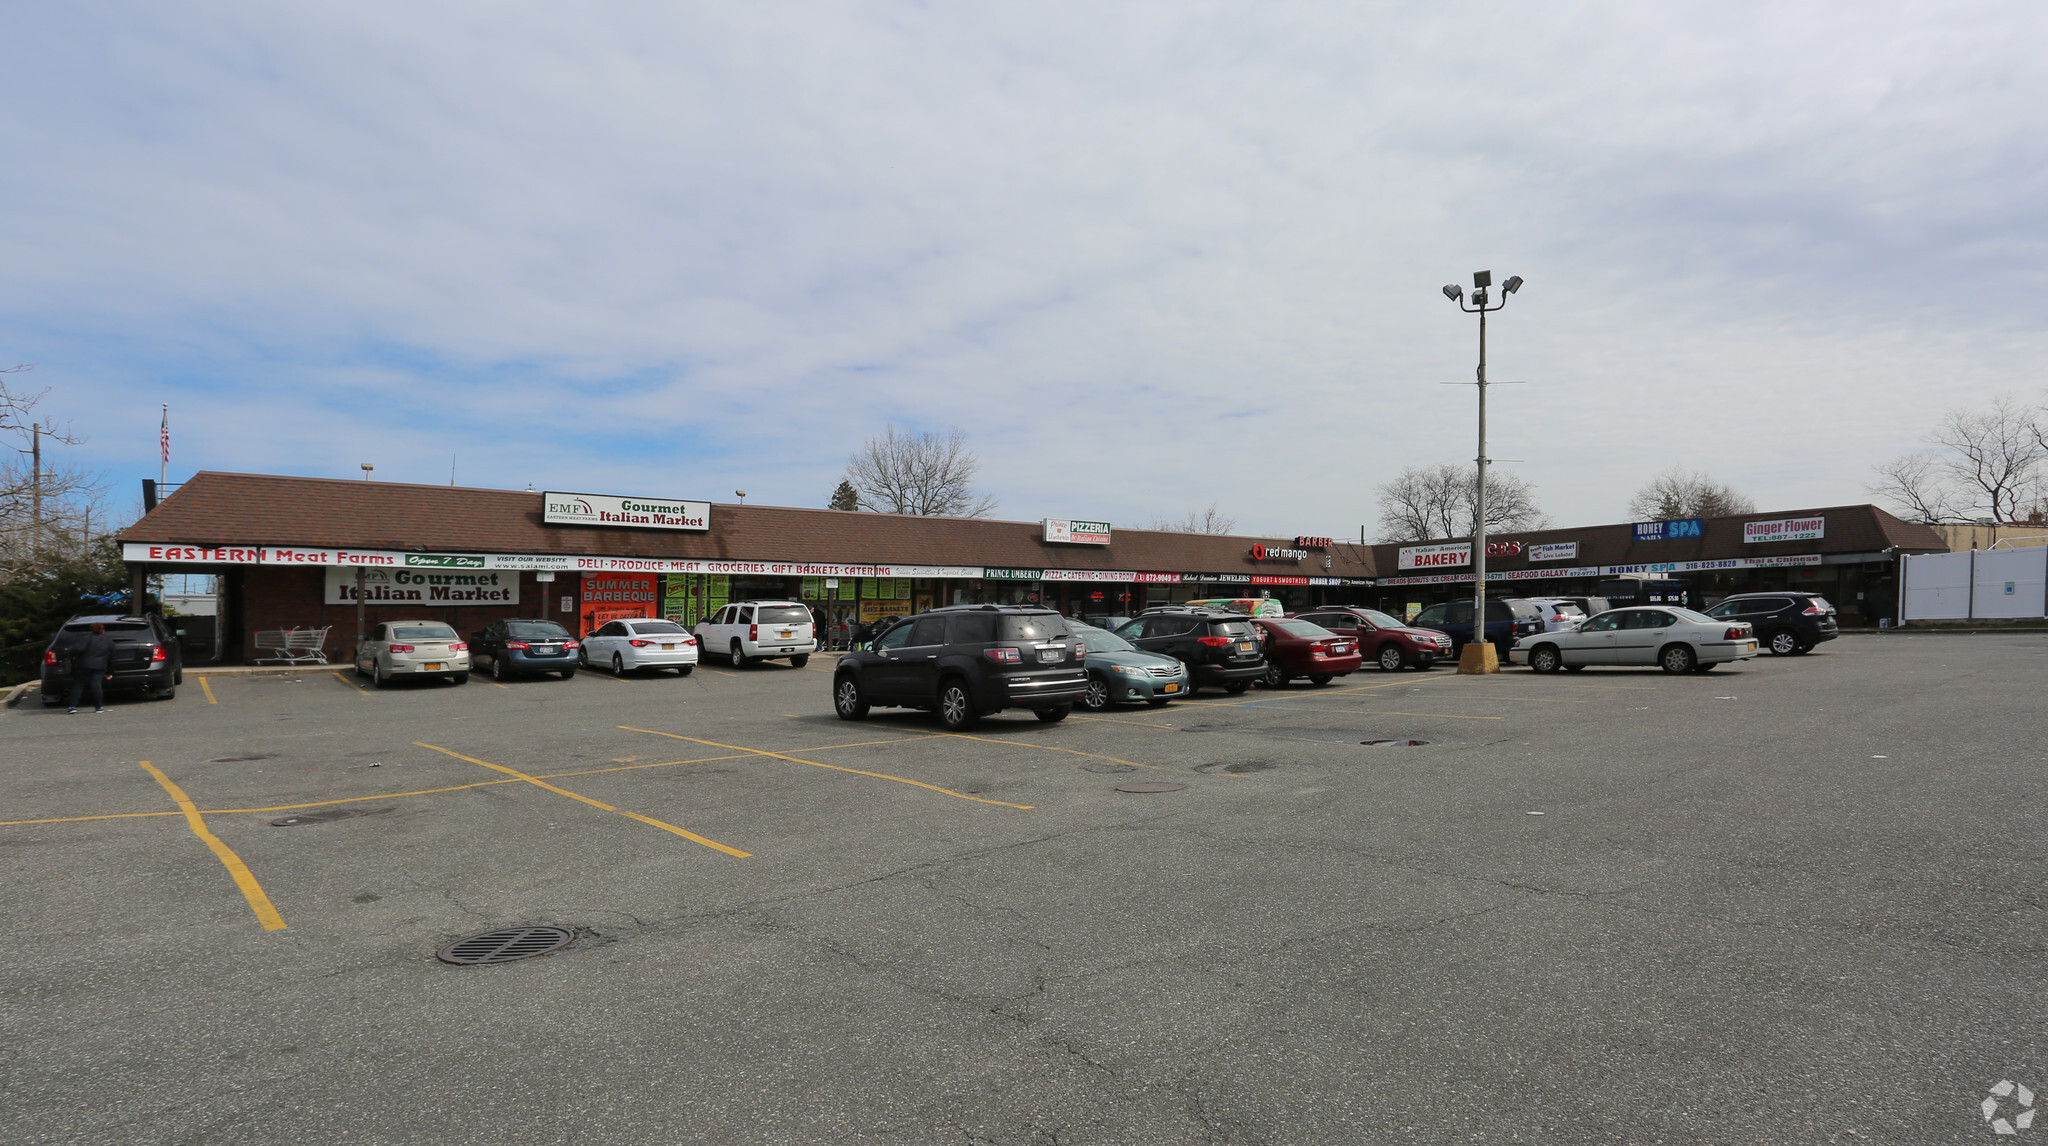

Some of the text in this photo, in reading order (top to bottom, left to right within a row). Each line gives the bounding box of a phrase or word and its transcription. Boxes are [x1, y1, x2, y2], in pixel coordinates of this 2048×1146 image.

[550, 503, 582, 514] EMF
[622, 500, 686, 514] Gourmet
[600, 511, 703, 527] Italian Market
[1071, 521, 1109, 534] PIZZERIA
[1637, 521, 1699, 537] HONEY SPA
[1746, 519, 1823, 536] Ginger Flower
[1300, 536, 1333, 547] BARBER
[150, 547, 394, 566] EASTERN Meat Farms
[1266, 547, 1307, 560] red mango
[1415, 552, 1467, 566] BAKERY
[408, 556, 439, 567] Open
[578, 559, 890, 576] DELI PRODUCE MEAT GROCERIES GIFT BASKETS CATERING
[986, 569, 1040, 579] PRINCE UMBERTO
[1507, 570, 1538, 579] SEAFOOD
[1540, 568, 1570, 578] GALAXY
[1609, 563, 1676, 574] HONEY SPA
[395, 570, 499, 586] Gourmet
[1045, 570, 1135, 581] PIZZA CATERING DINING ROOM
[1219, 574, 1250, 582] JEWELERS
[1387, 577, 1407, 585] BREADS
[1440, 574, 1459, 582] CREAM
[586, 580, 650, 590] SUMMER
[339, 585, 511, 601] Italian Market
[583, 591, 655, 601] BARBEQUE
